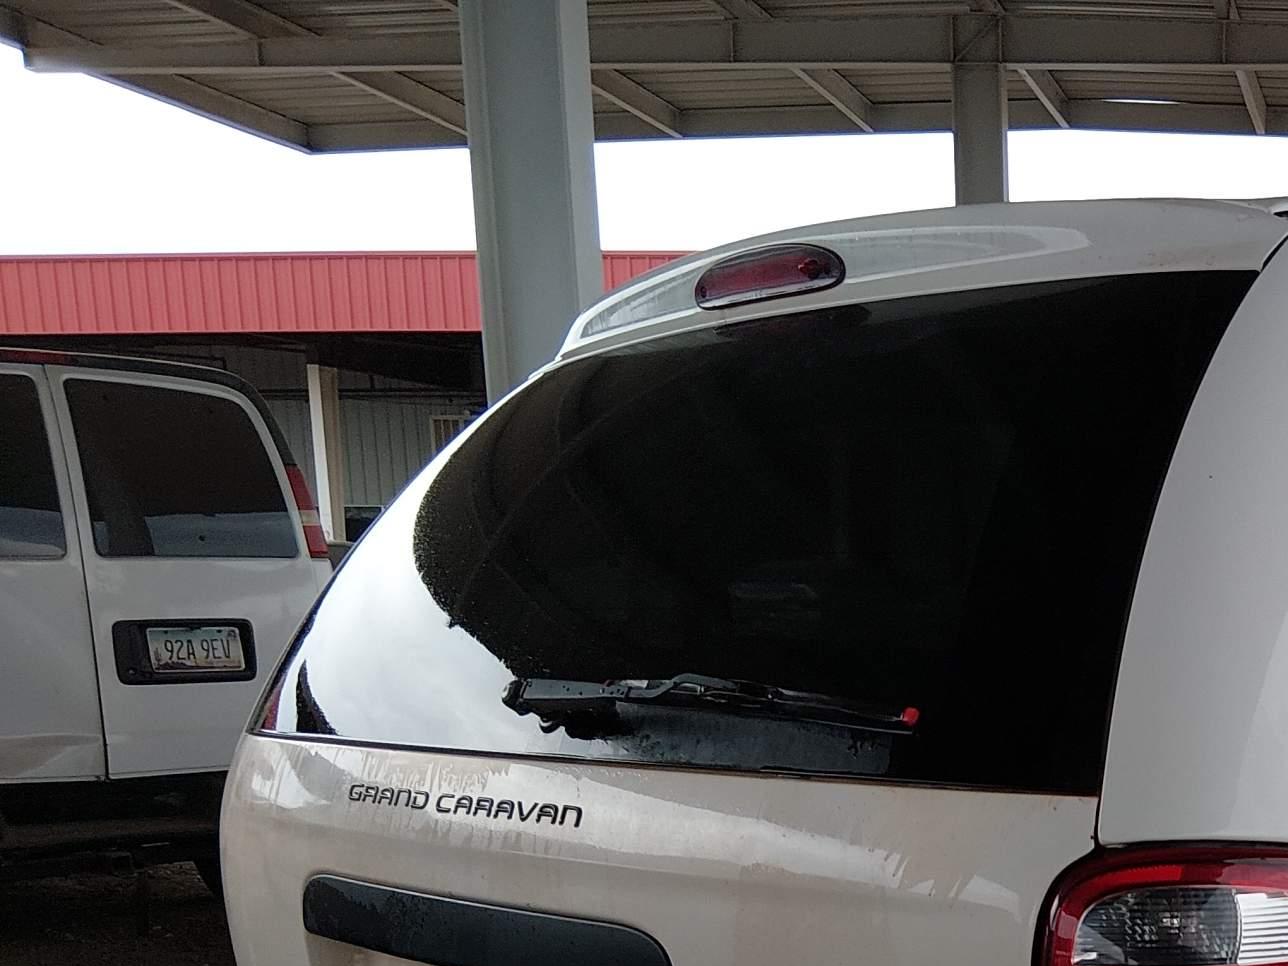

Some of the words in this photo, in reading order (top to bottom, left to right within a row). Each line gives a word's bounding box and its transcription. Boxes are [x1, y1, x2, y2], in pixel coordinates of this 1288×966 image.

[163, 639, 197, 661] 92A
[200, 638, 231, 659] 9EV
[348, 783, 430, 810] GRAND
[435, 793, 583, 828] CARAVAN
